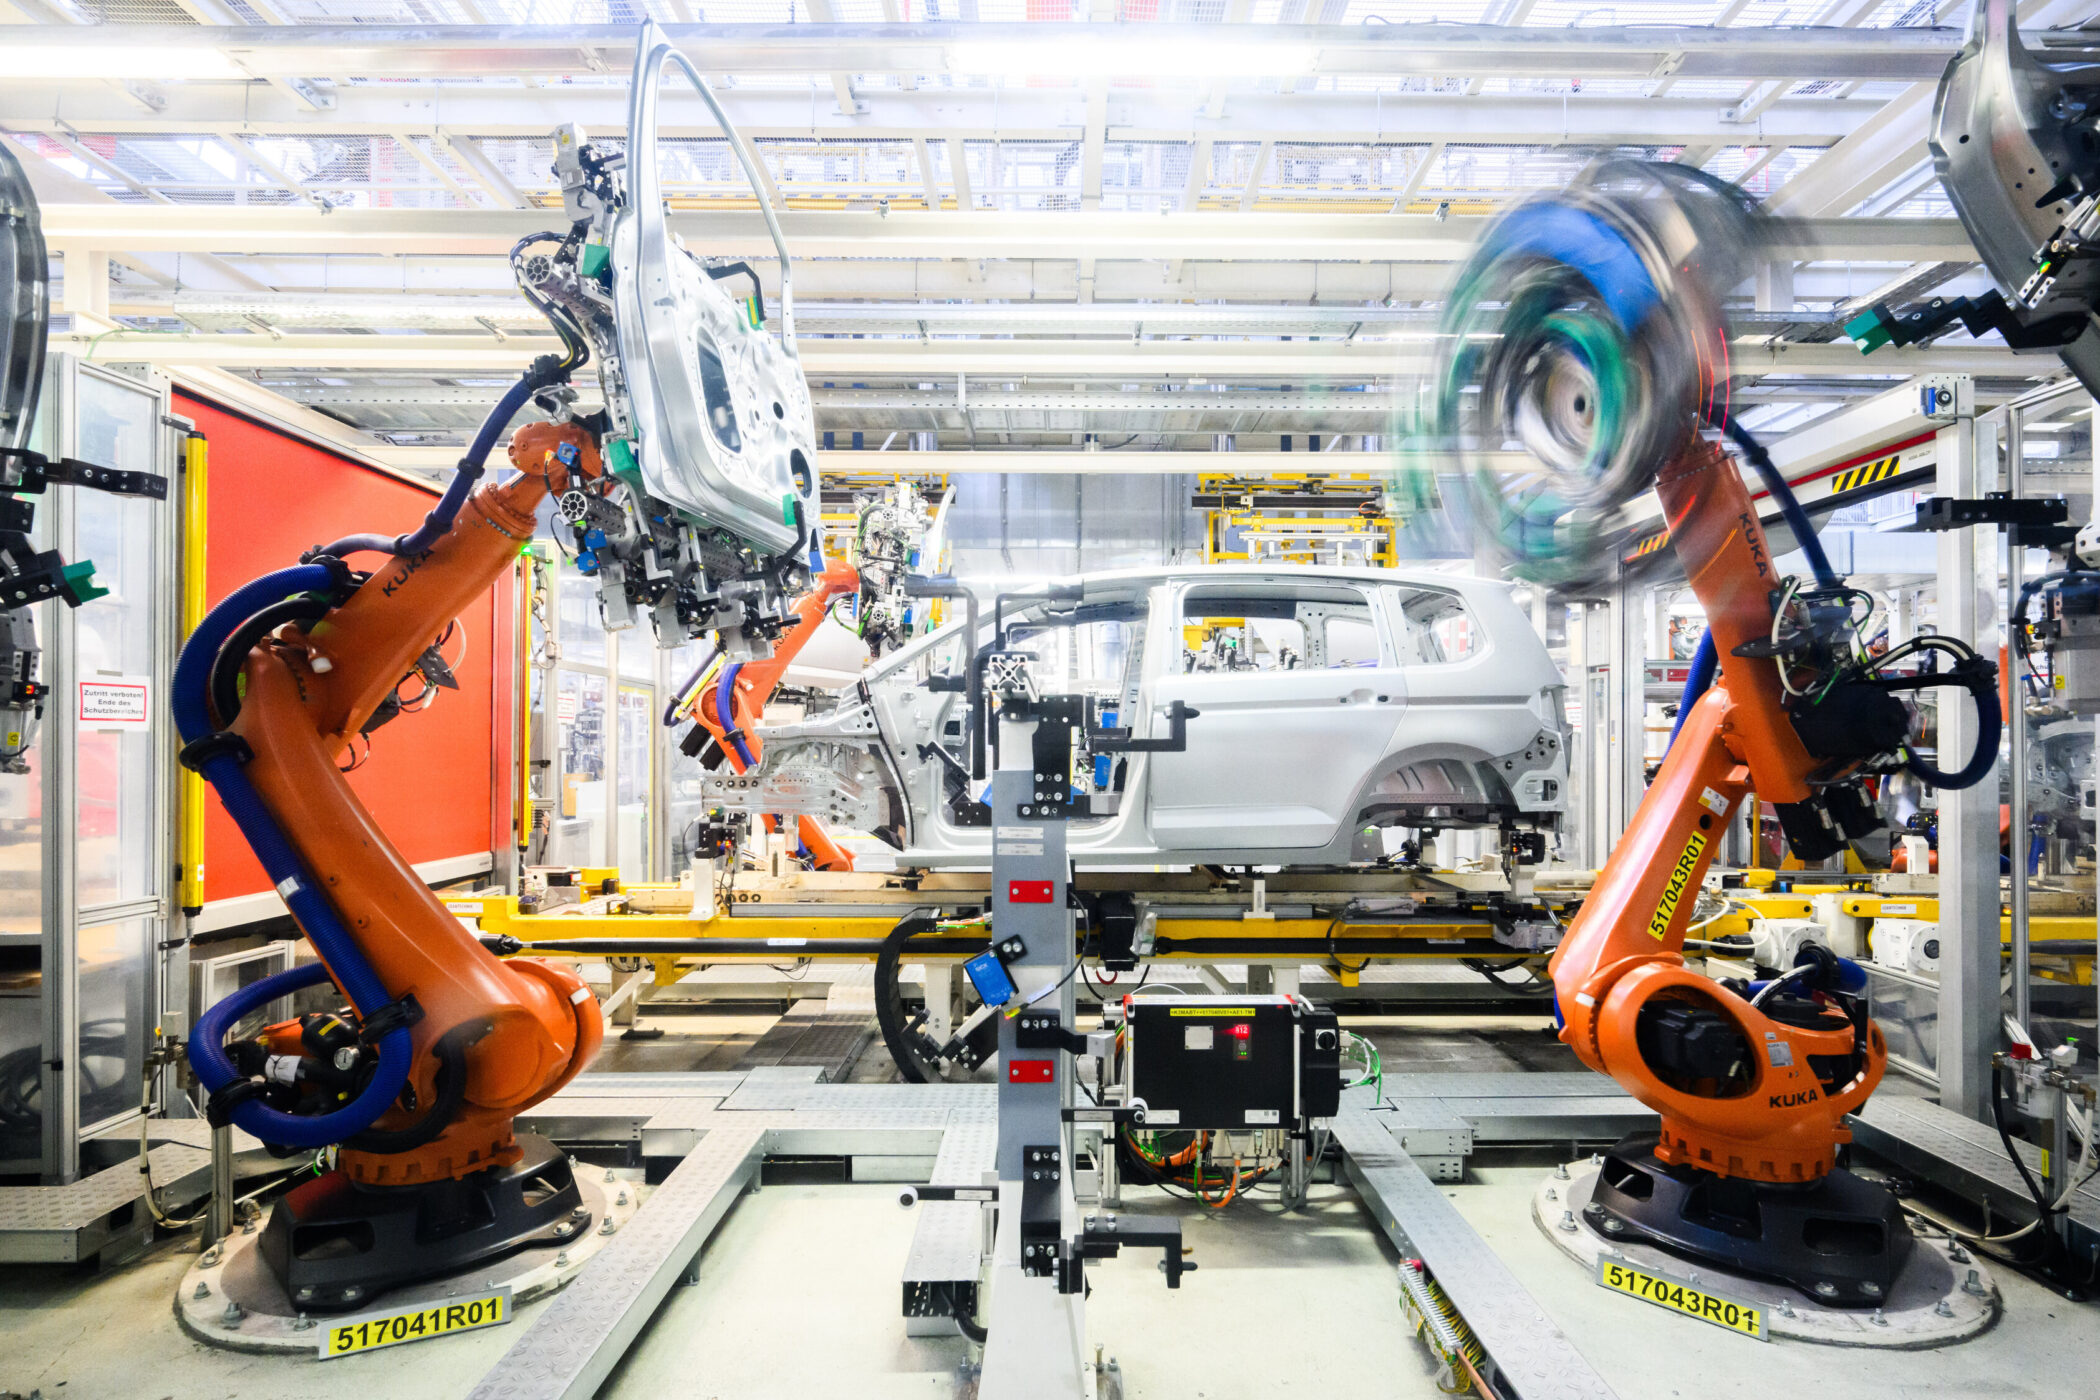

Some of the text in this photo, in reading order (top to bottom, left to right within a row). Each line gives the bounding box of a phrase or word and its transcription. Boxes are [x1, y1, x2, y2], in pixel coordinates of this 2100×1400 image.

[1739, 512, 1767, 577] KUKA
[382, 548, 434, 597] KUKA
[83, 689, 109, 697] Zutritt
[1650, 834, 1705, 936] 517043R01
[1769, 1088, 1818, 1108] KUKA
[336, 1298, 497, 1351] 517041R01
[1609, 1266, 1756, 1332] 517043R01
